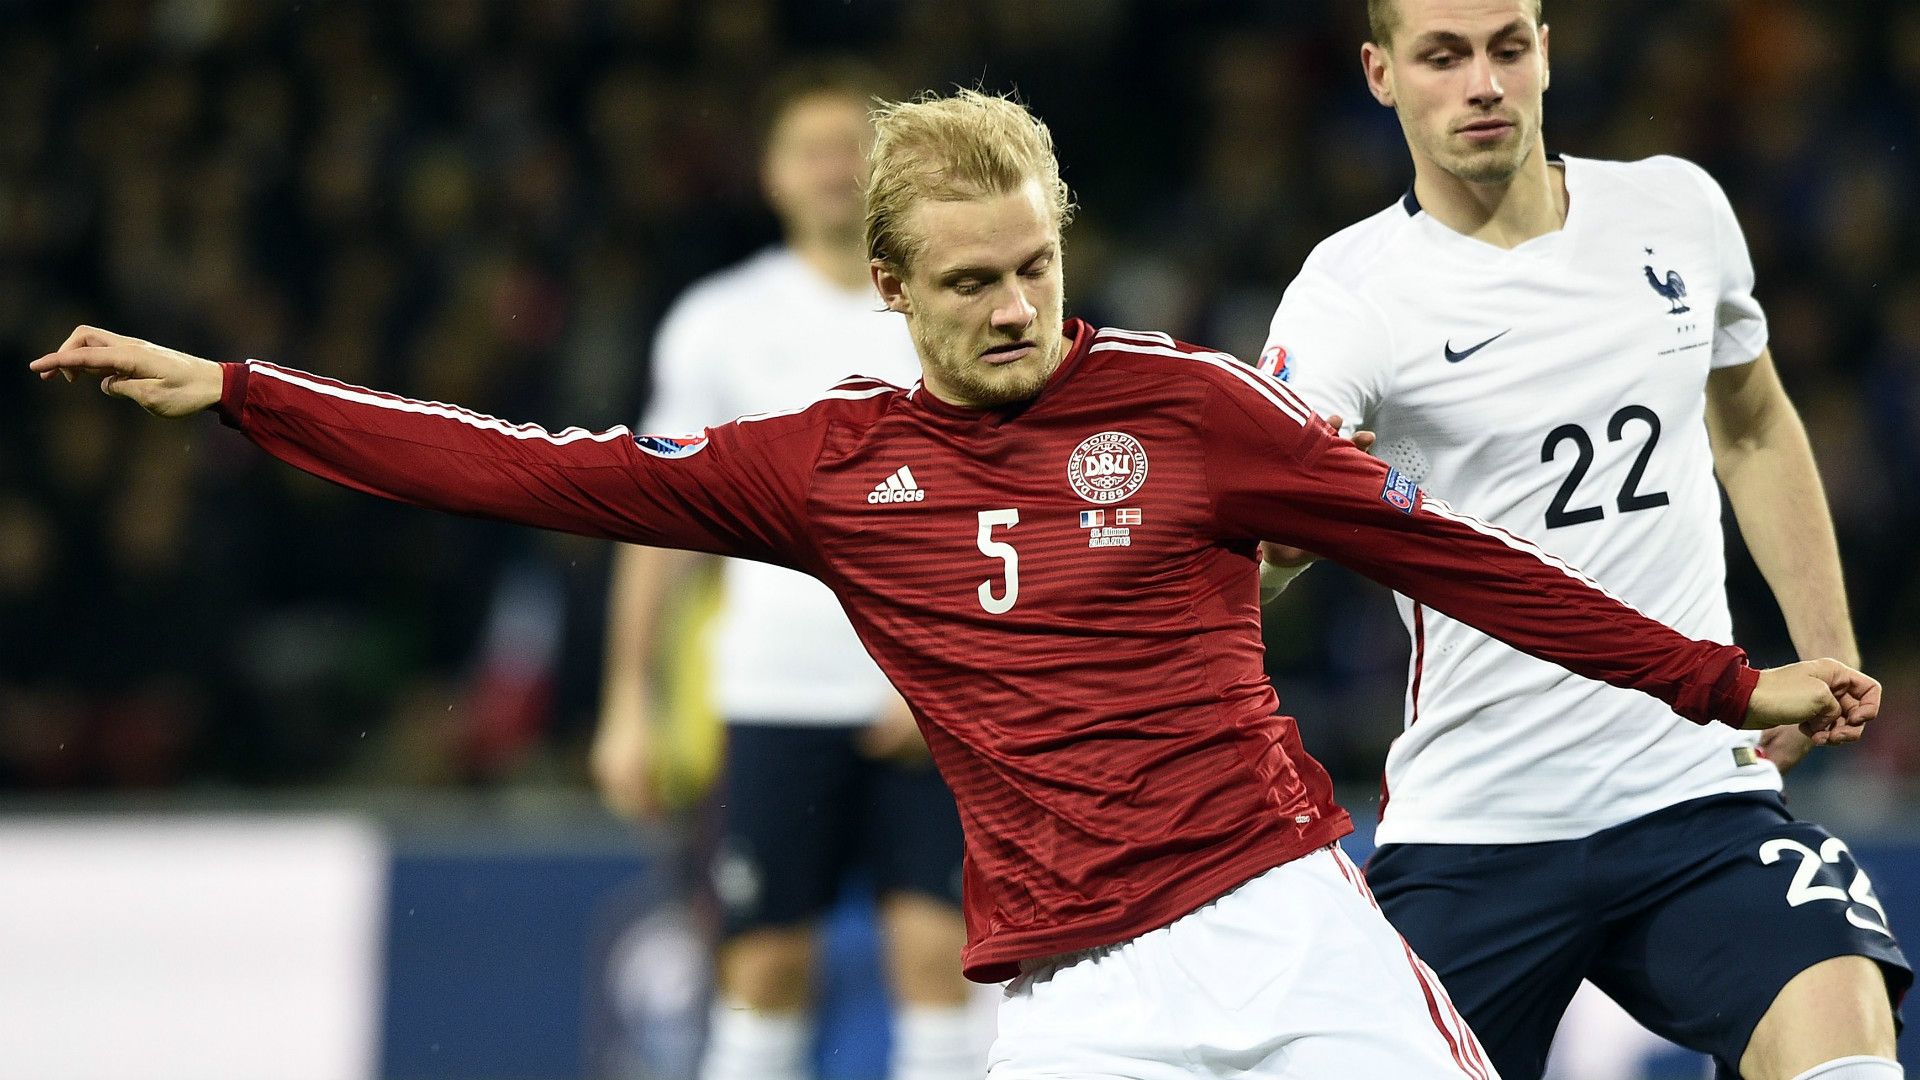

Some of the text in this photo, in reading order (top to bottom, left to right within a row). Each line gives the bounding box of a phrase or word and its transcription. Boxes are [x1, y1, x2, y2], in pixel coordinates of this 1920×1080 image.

[1071, 453, 1090, 495] DANSK
[1127, 453, 1145, 490] UNION
[1085, 453, 1130, 477] DBU
[1541, 404, 1670, 530] 22
[867, 489, 924, 504] adidas
[1093, 489, 1124, 500] 1889
[977, 508, 1020, 615] 5
